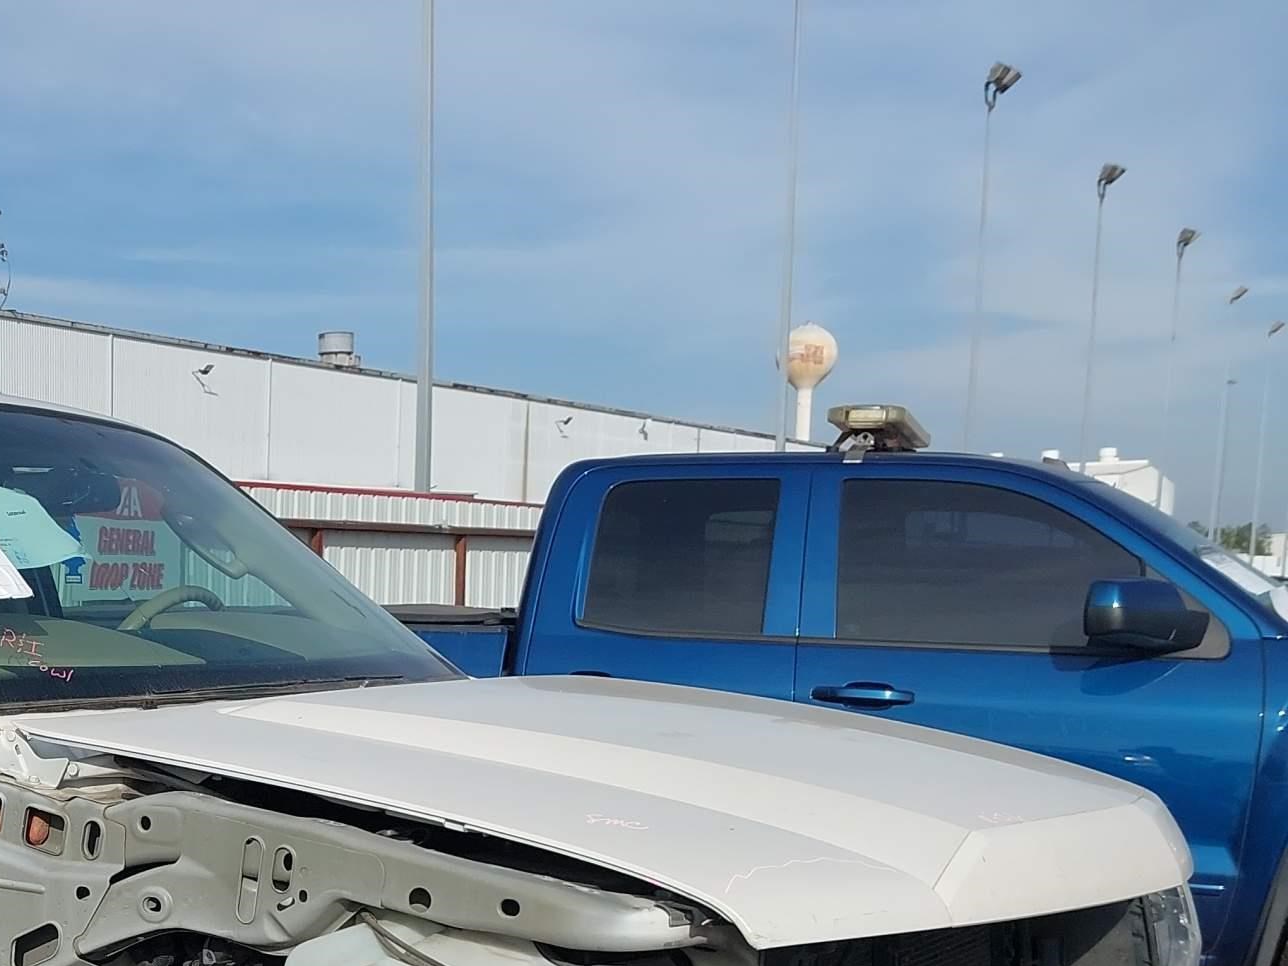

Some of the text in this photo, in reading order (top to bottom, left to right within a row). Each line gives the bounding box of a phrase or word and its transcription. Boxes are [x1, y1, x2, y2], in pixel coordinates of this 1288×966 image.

[97, 526, 156, 556] GENERAL
[89, 561, 165, 591] DROP ZONE
